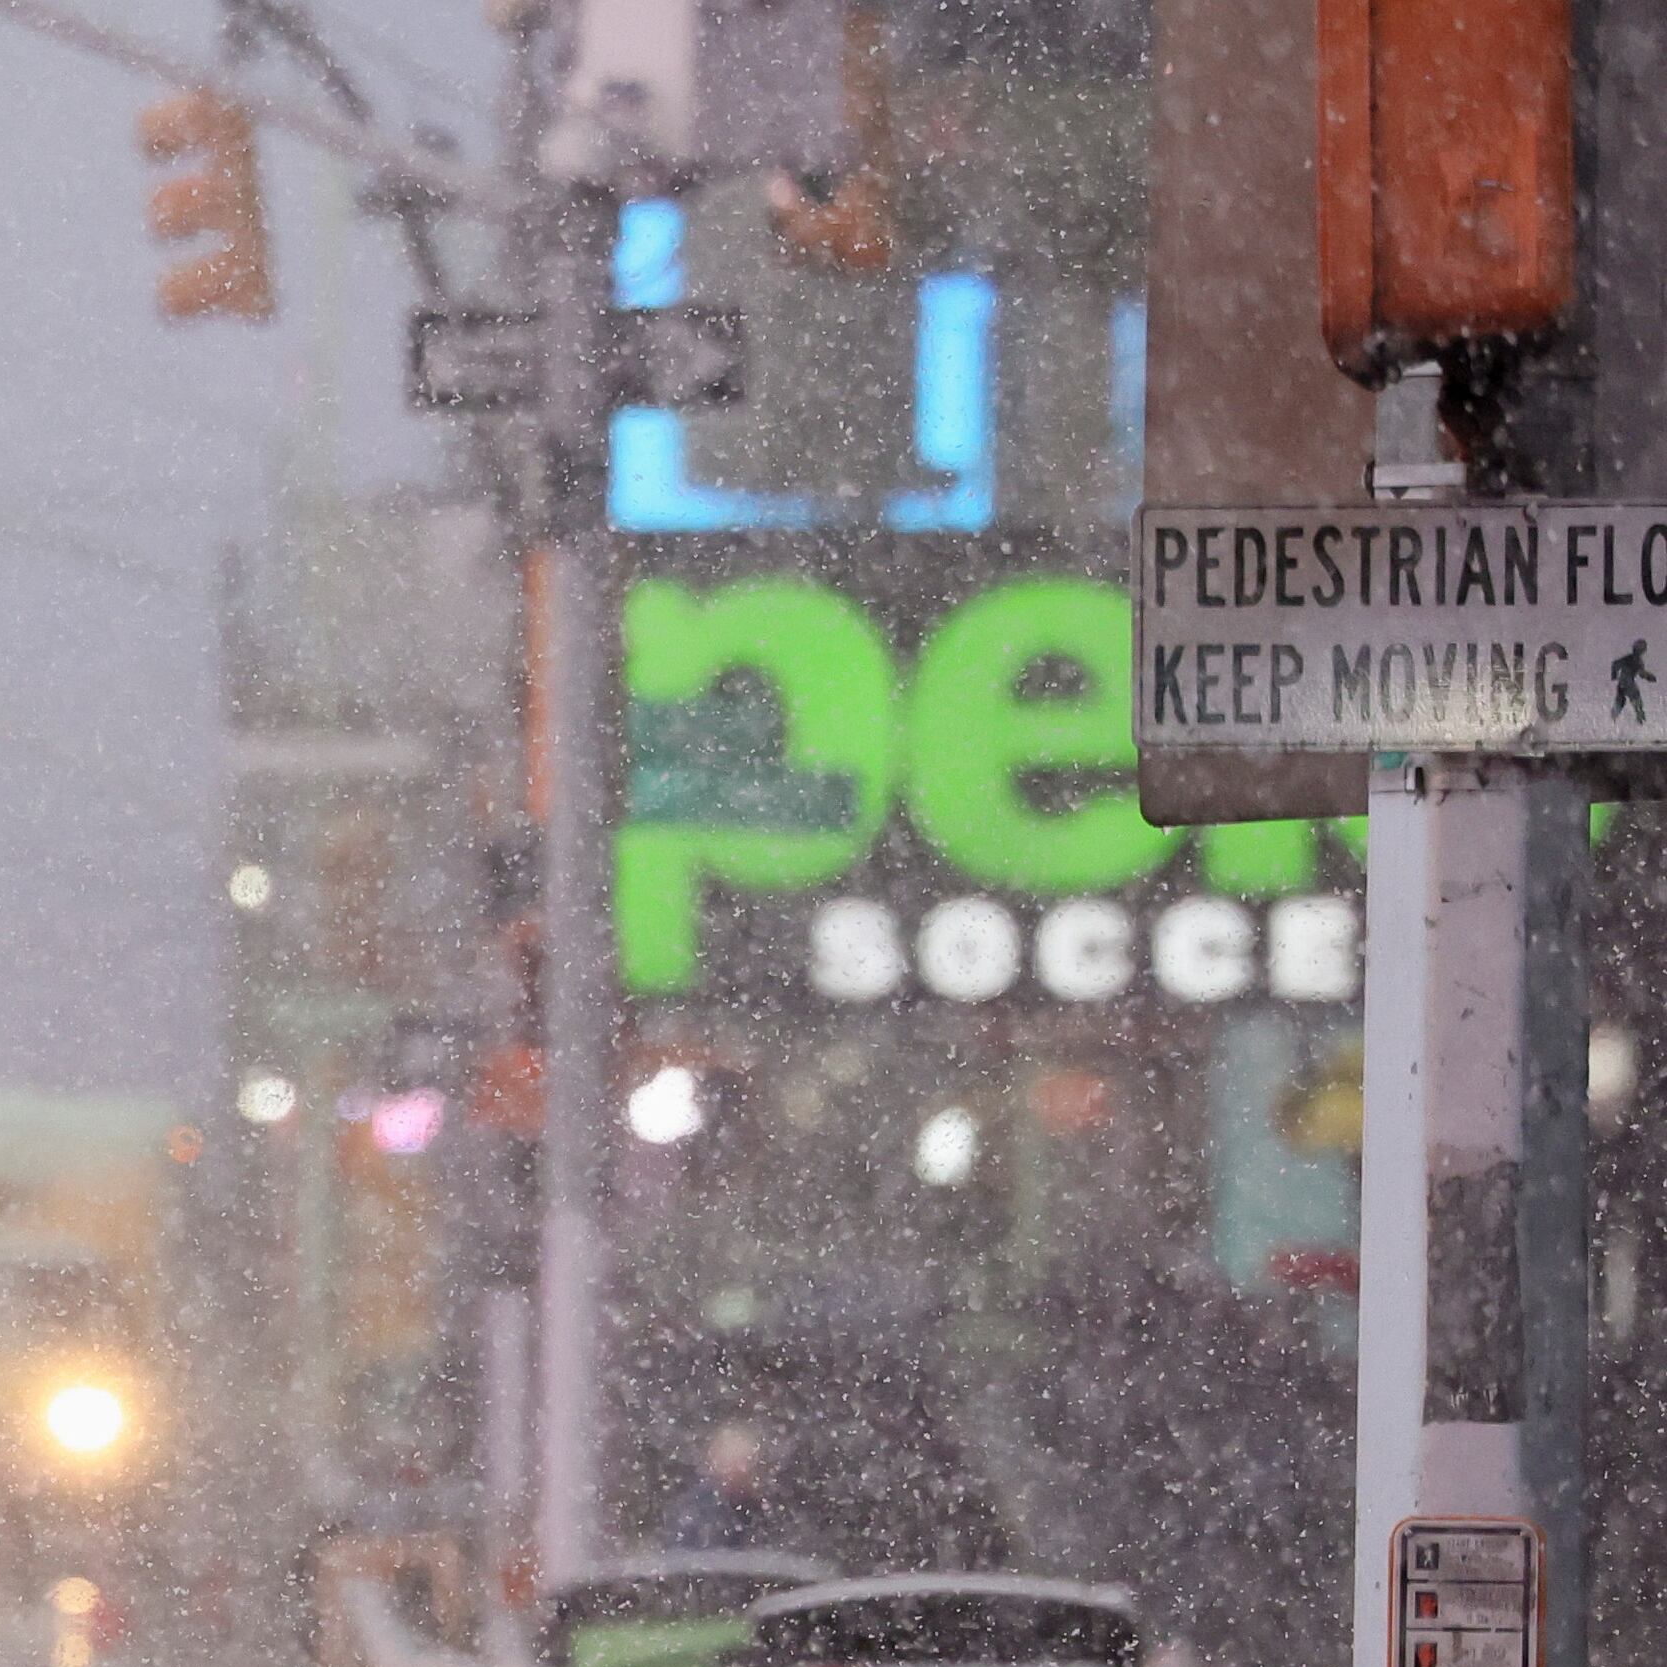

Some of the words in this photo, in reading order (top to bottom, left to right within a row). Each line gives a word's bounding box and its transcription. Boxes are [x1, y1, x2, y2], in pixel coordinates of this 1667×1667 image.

[1154, 525, 1539, 607] PEDESTRIAN
[1153, 643, 1305, 725] KEEP
[1332, 641, 1569, 724] MOVING
